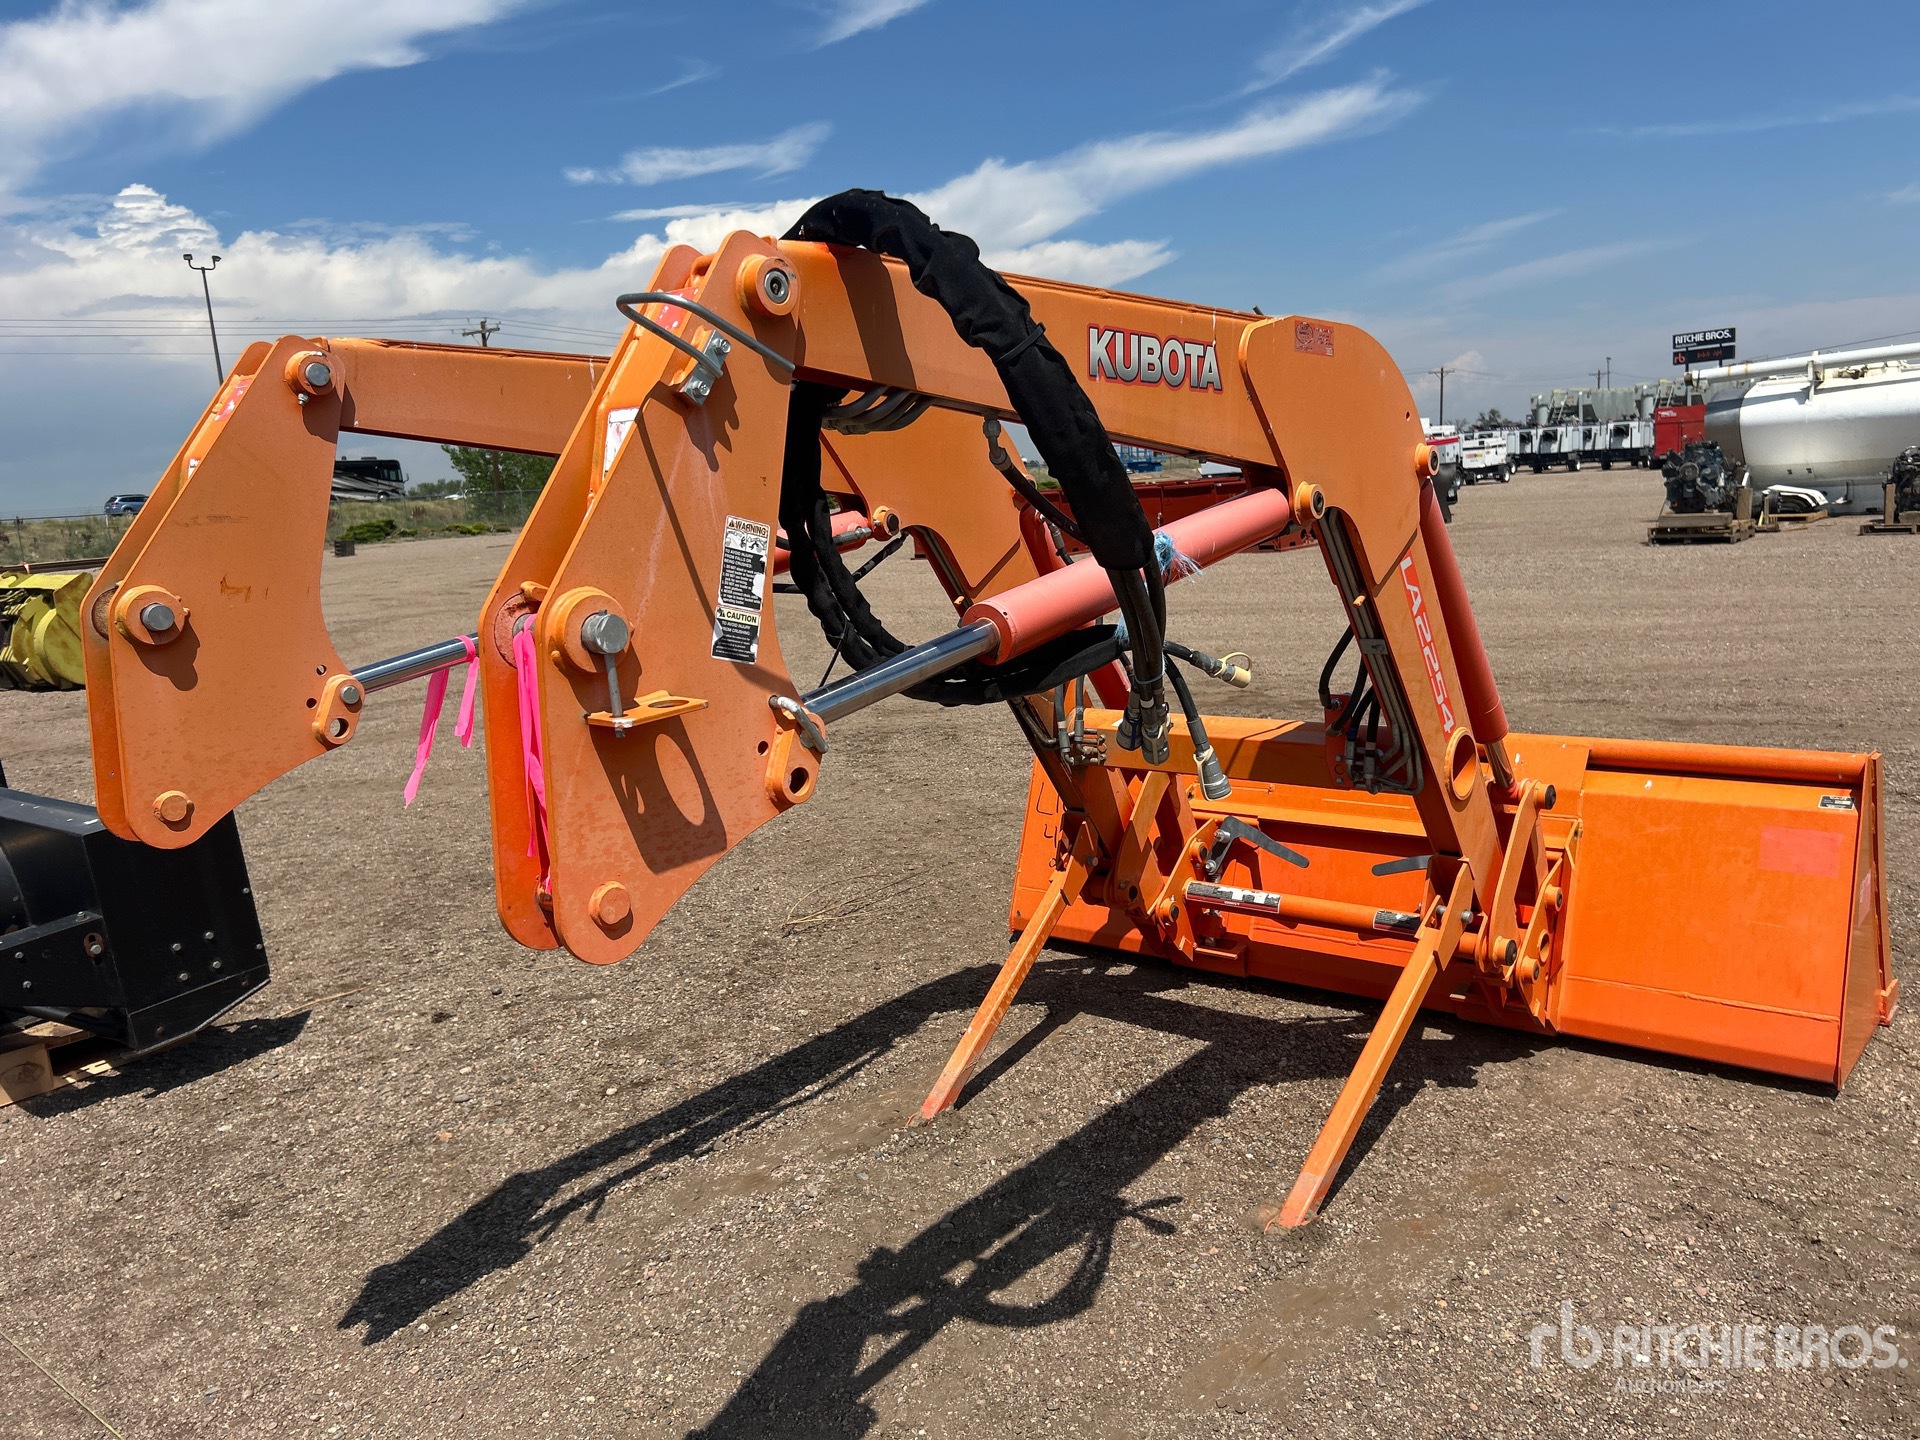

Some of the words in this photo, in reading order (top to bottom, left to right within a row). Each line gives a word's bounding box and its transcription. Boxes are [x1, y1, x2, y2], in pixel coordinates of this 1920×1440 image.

[1675, 332, 1704, 344] RITCHIE
[1706, 329, 1732, 340] BROS.
[1088, 326, 1222, 391] KUBOTA
[1674, 352, 1686, 364] rb
[736, 520, 766, 536] WARNING
[726, 612, 757, 623] CAUTION
[1400, 556, 1455, 734] LA2254
